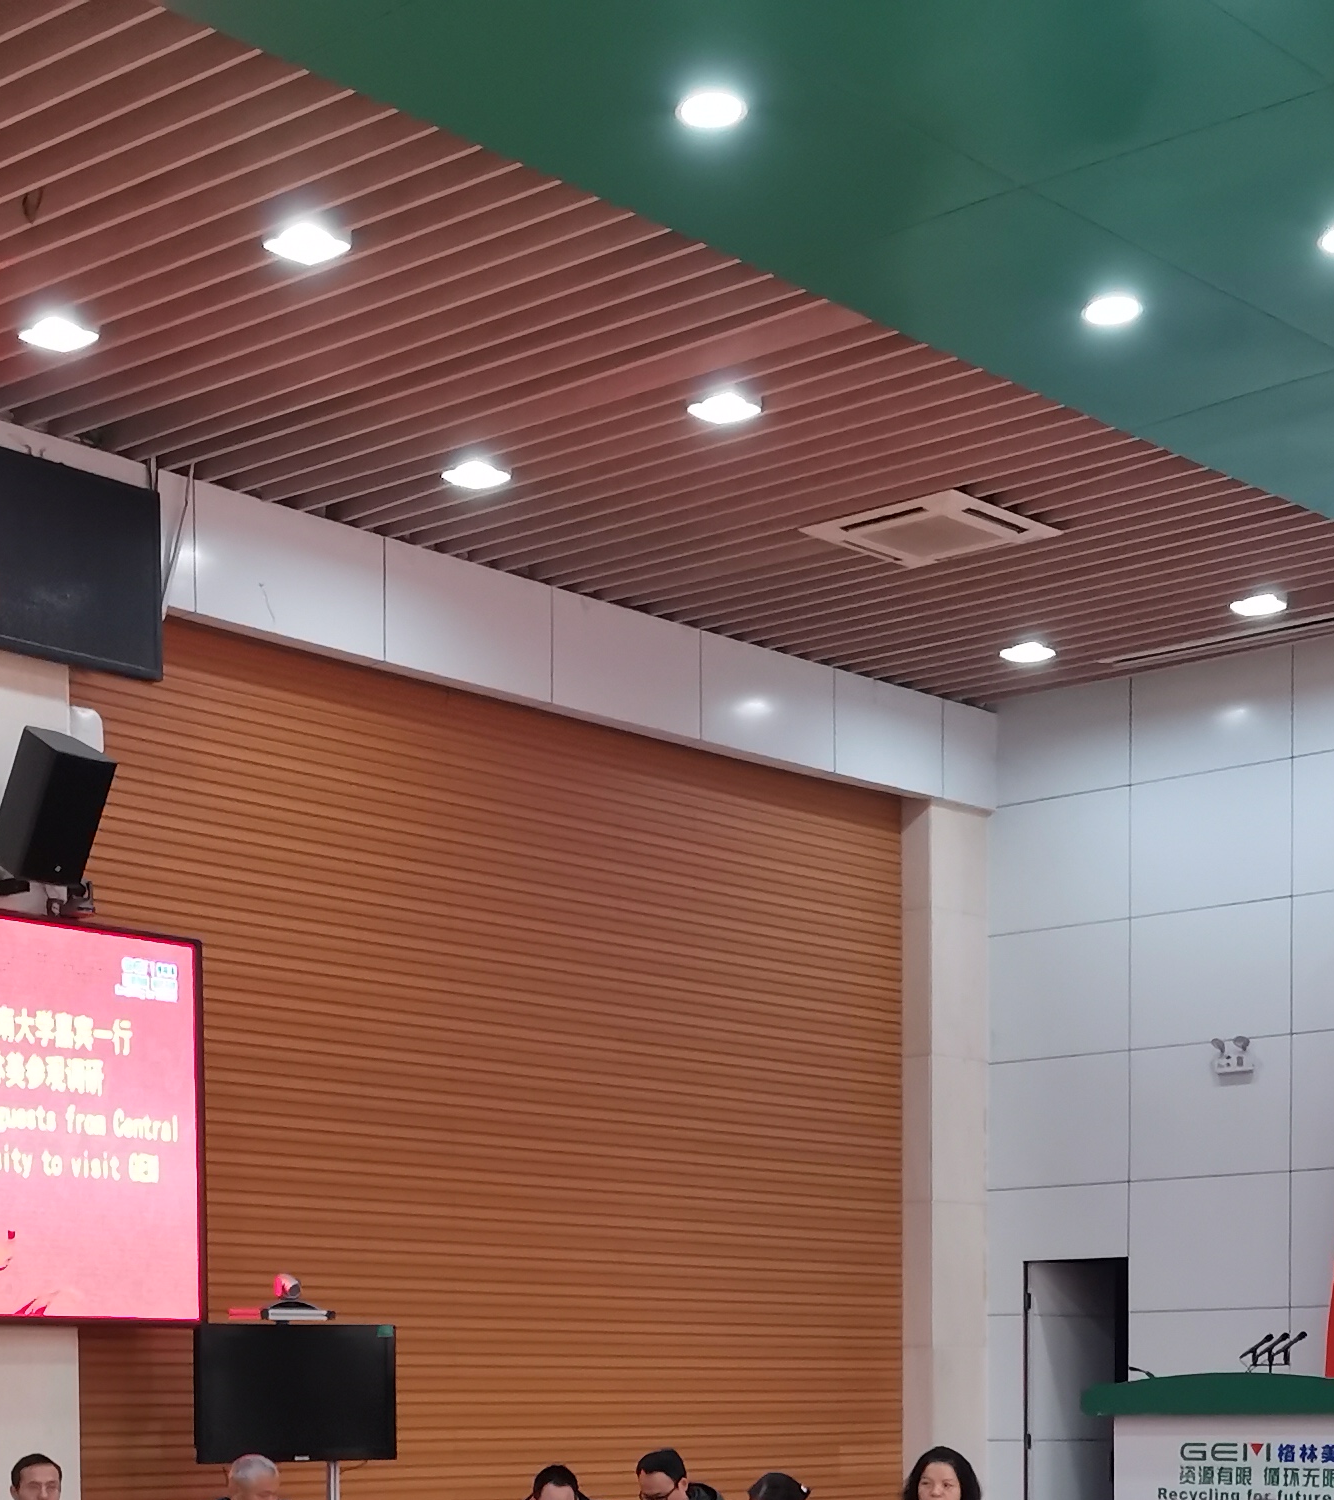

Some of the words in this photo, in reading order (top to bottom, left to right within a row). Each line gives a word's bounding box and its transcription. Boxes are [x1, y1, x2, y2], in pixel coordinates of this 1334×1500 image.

[65, 1103, 107, 1137] from
[112, 1107, 179, 1143] Central
[41, 1149, 63, 1177] to
[70, 1149, 122, 1182] visit
[1179, 1442, 1272, 1463] GEM
[1179, 1465, 1253, 1487] 资源有限
